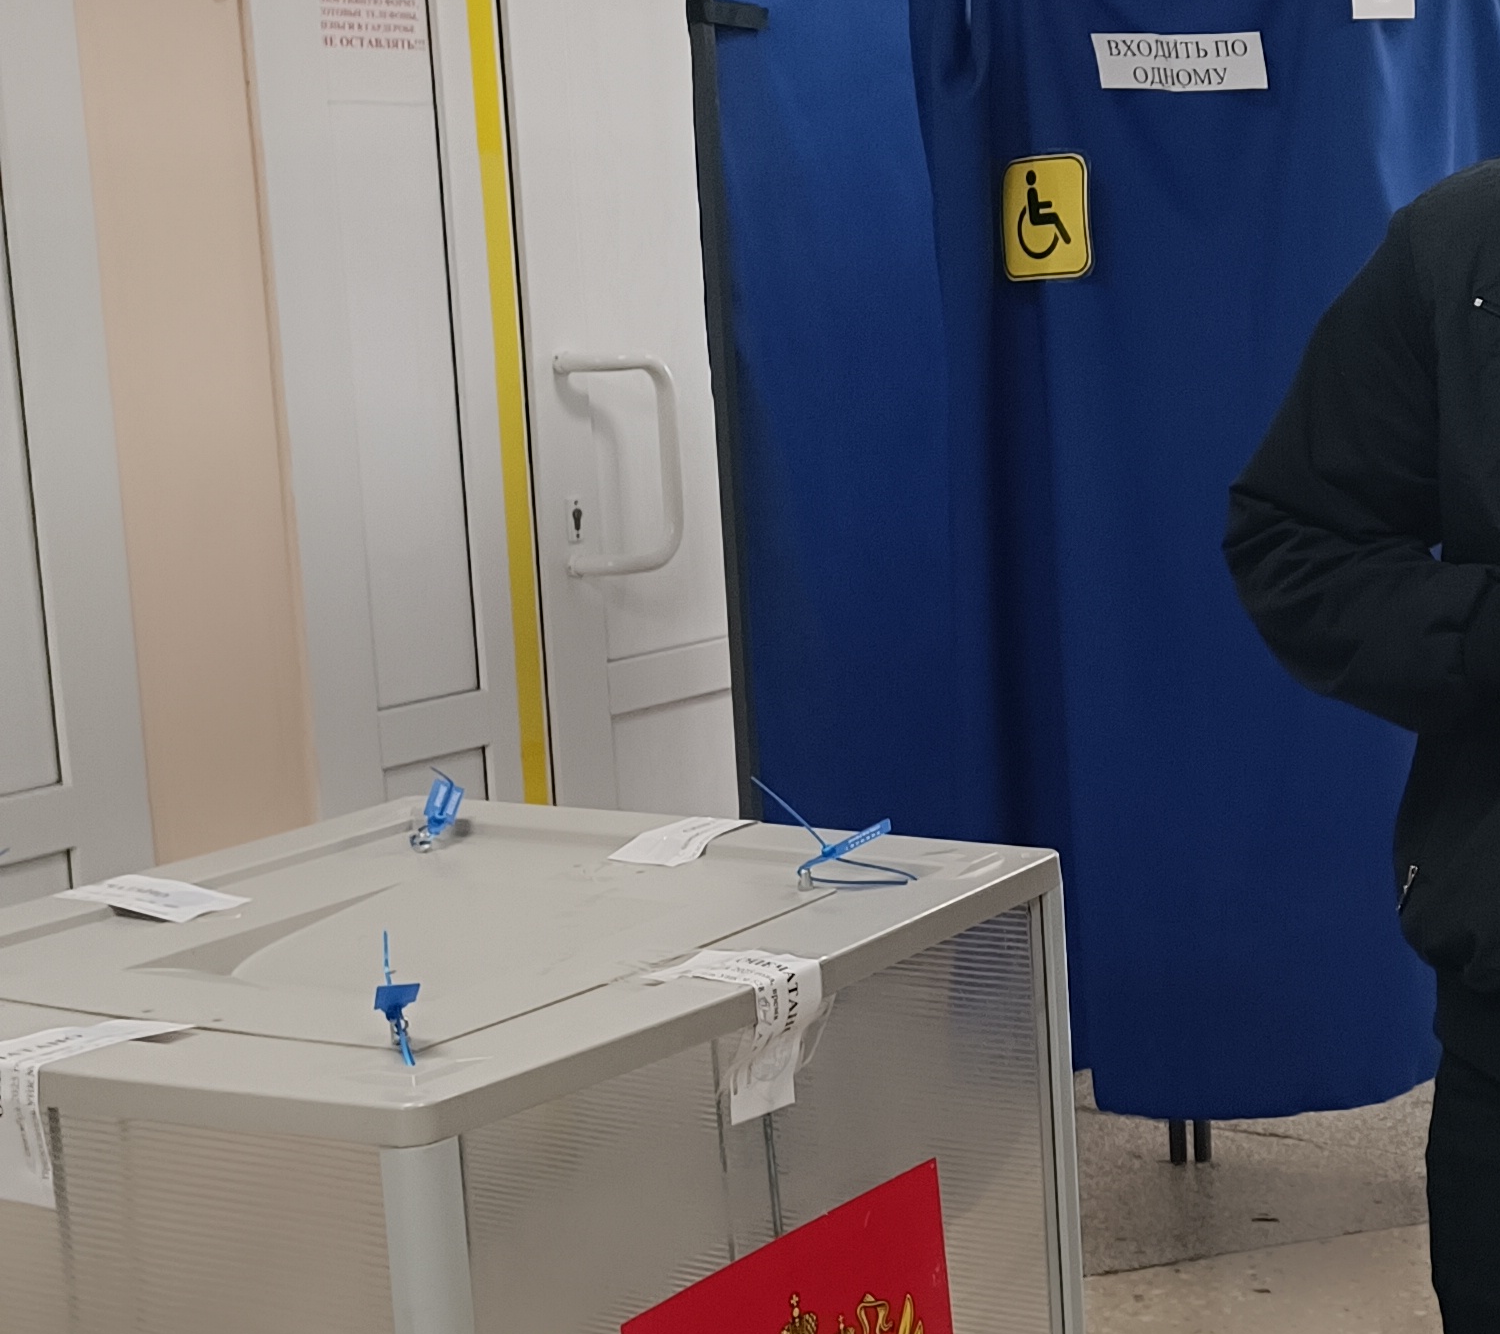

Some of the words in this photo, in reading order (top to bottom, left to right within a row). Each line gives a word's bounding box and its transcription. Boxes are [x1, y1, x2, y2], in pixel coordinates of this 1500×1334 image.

[1107, 38, 1209, 61] ВХОДИТЬ
[1214, 38, 1248, 58] ПО
[1133, 66, 1227, 88] ОДНОМУ
